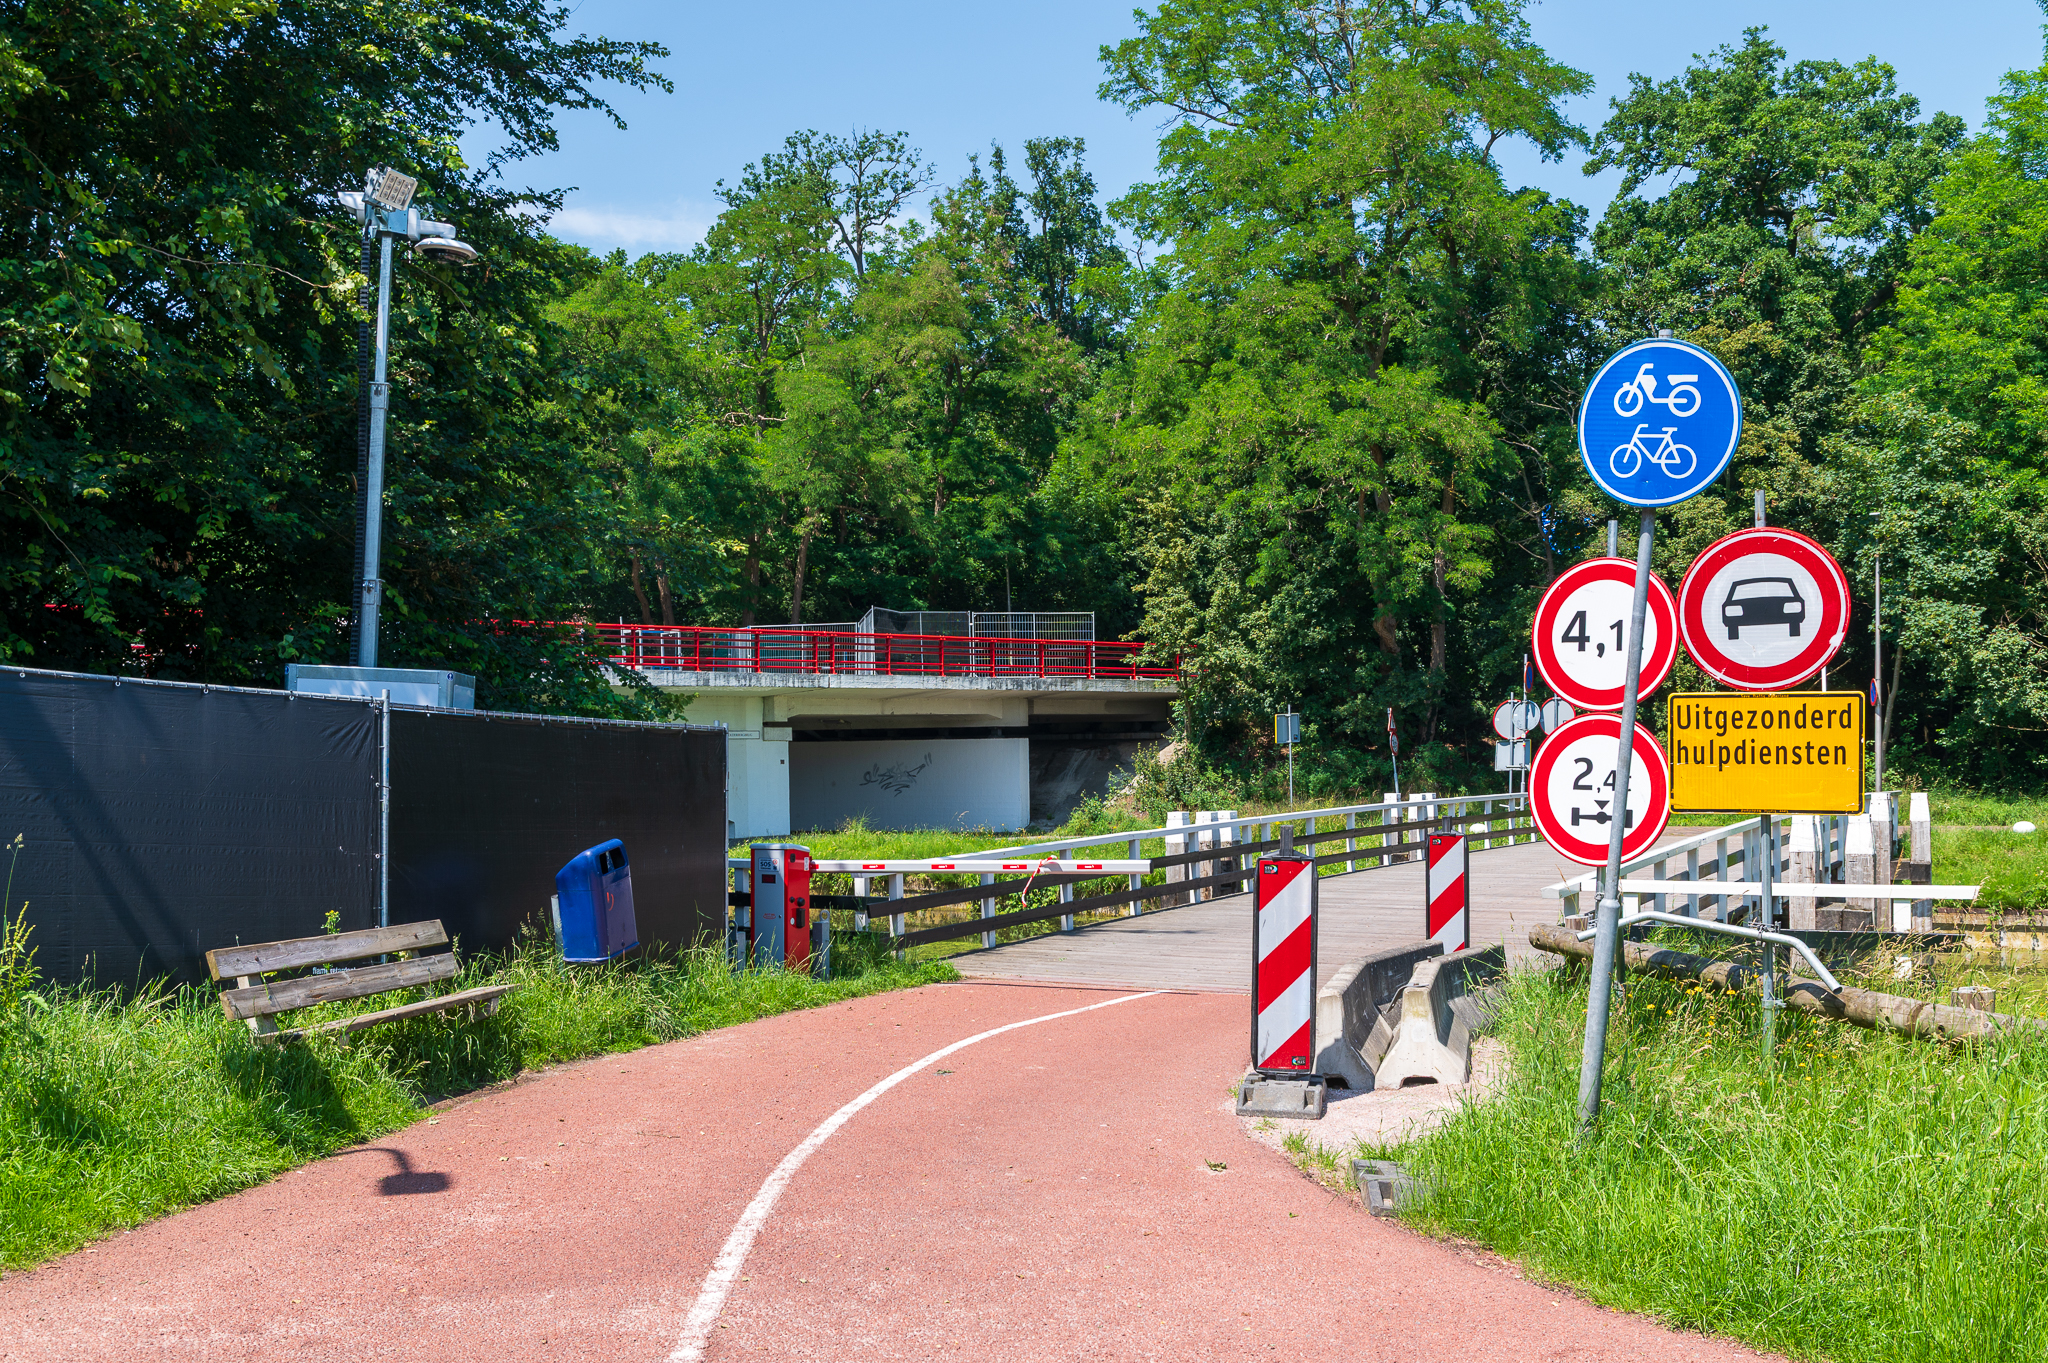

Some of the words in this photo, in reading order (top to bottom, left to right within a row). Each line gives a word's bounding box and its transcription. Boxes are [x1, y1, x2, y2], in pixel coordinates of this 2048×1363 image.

[1561, 610, 1644, 659] 4,1
[1676, 702, 1852, 737] Uitgezonderd
[1677, 739, 1847, 772] hulpdiensten
[1572, 757, 1632, 794] 2,4
